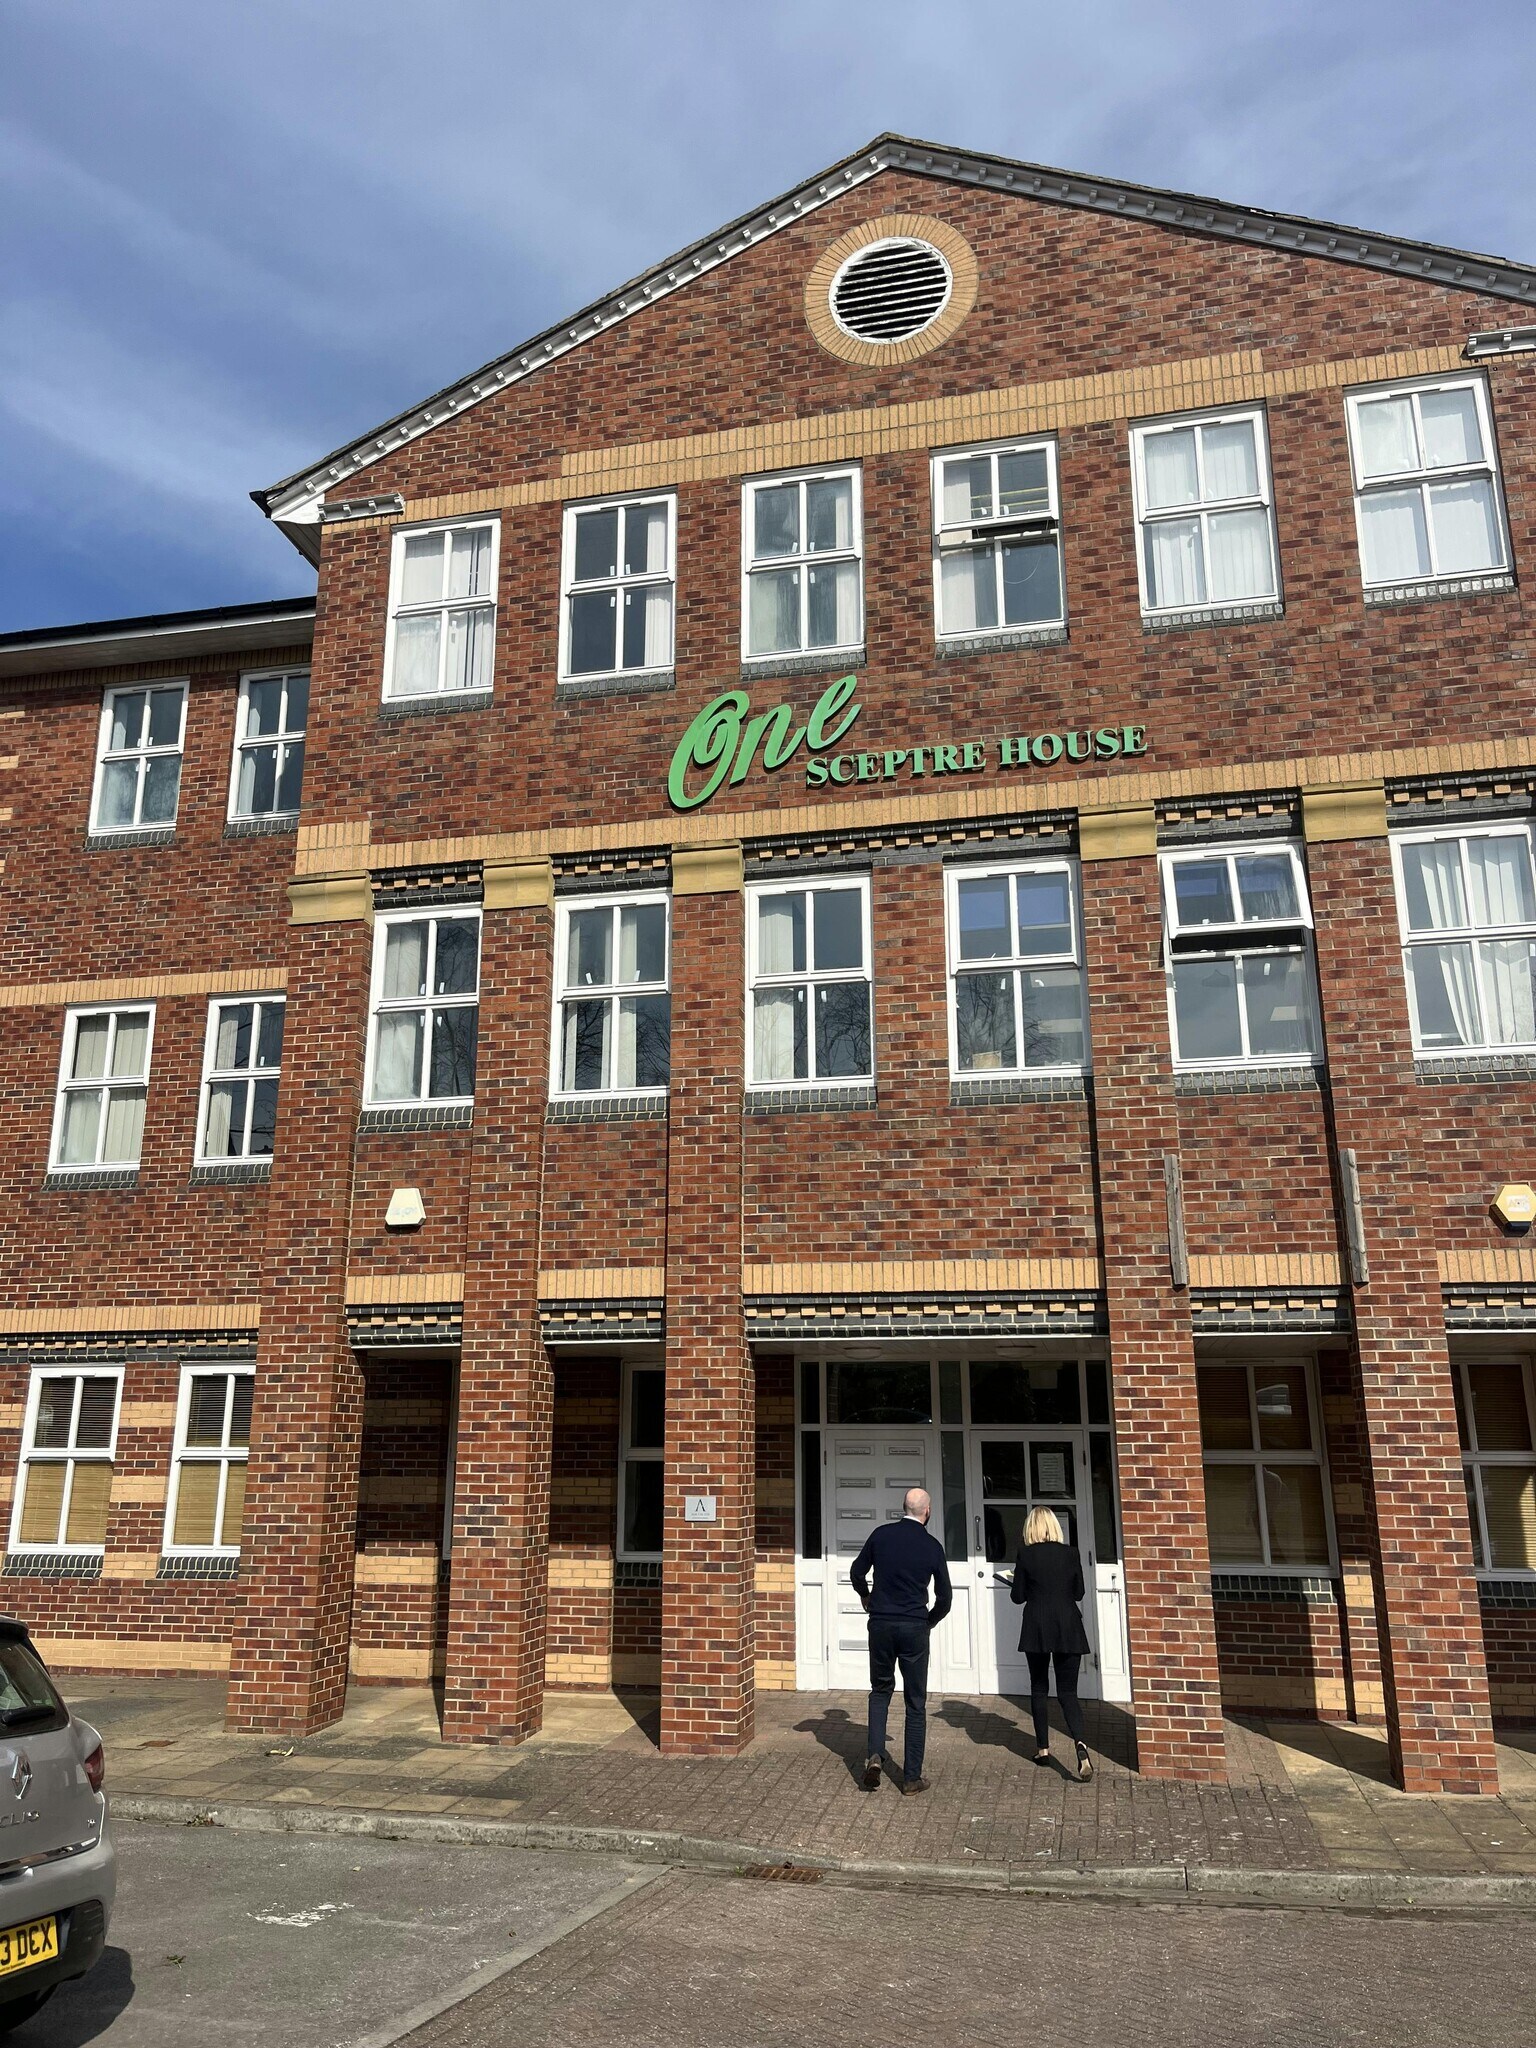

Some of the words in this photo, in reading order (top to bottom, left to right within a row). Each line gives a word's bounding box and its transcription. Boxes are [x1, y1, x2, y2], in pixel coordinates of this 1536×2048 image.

[668, 675, 862, 808] One
[806, 741, 987, 785] SCEPTRE
[999, 725, 1148, 765] HOUSE
